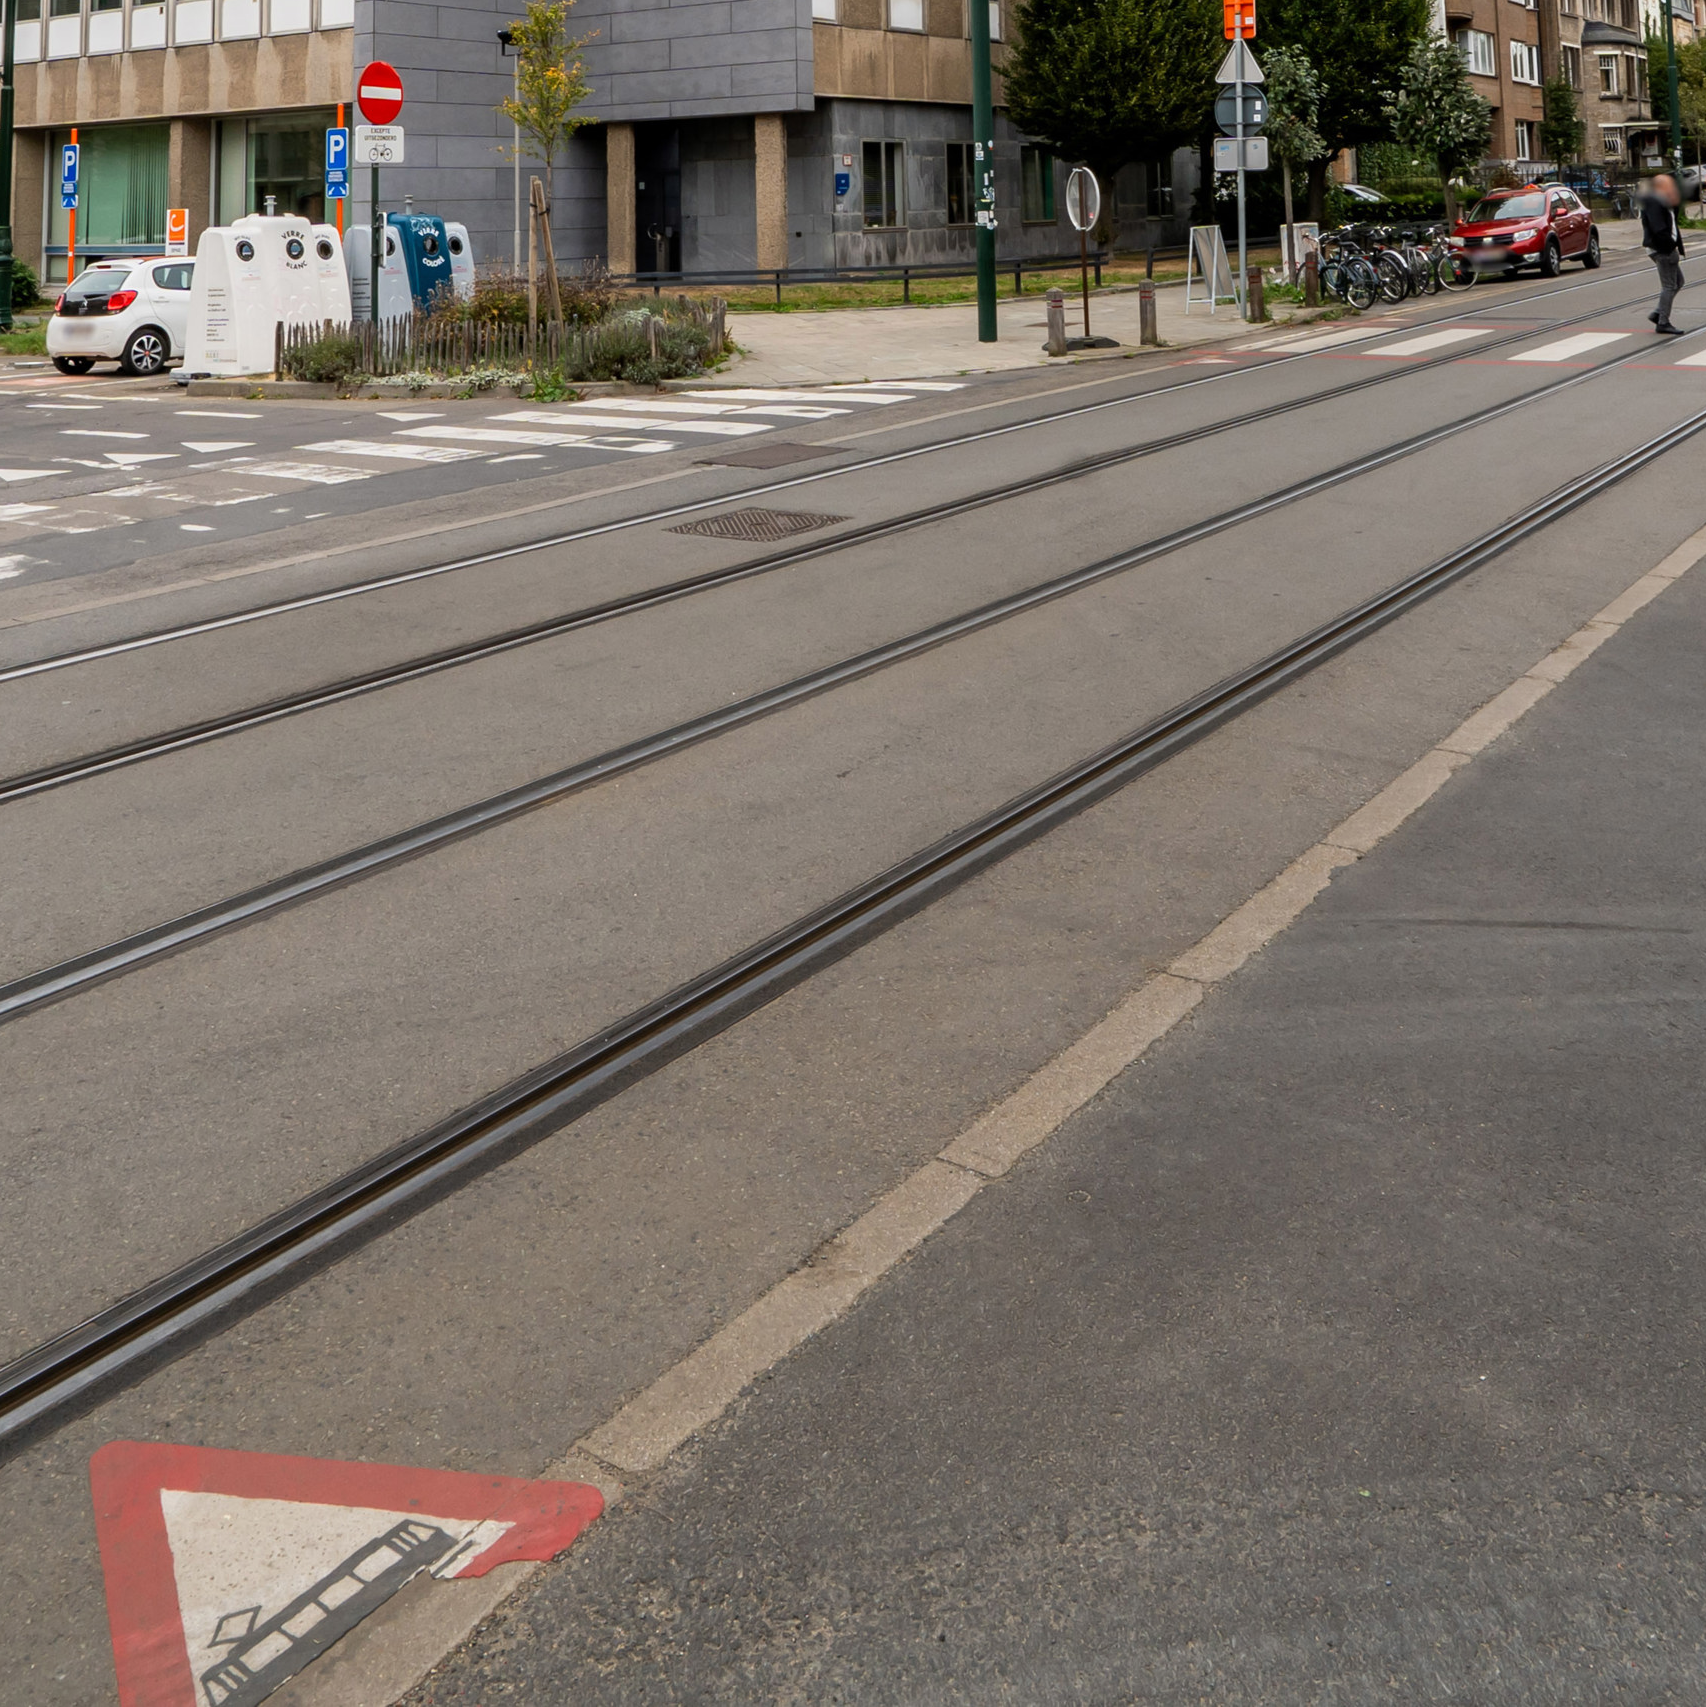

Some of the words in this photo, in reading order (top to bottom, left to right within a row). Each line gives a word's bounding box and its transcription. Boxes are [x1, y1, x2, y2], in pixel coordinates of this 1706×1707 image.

[329, 134, 345, 164] P
[64, 150, 76, 177] P
[281, 230, 305, 240] VERRE
[286, 260, 308, 270] BLANC
